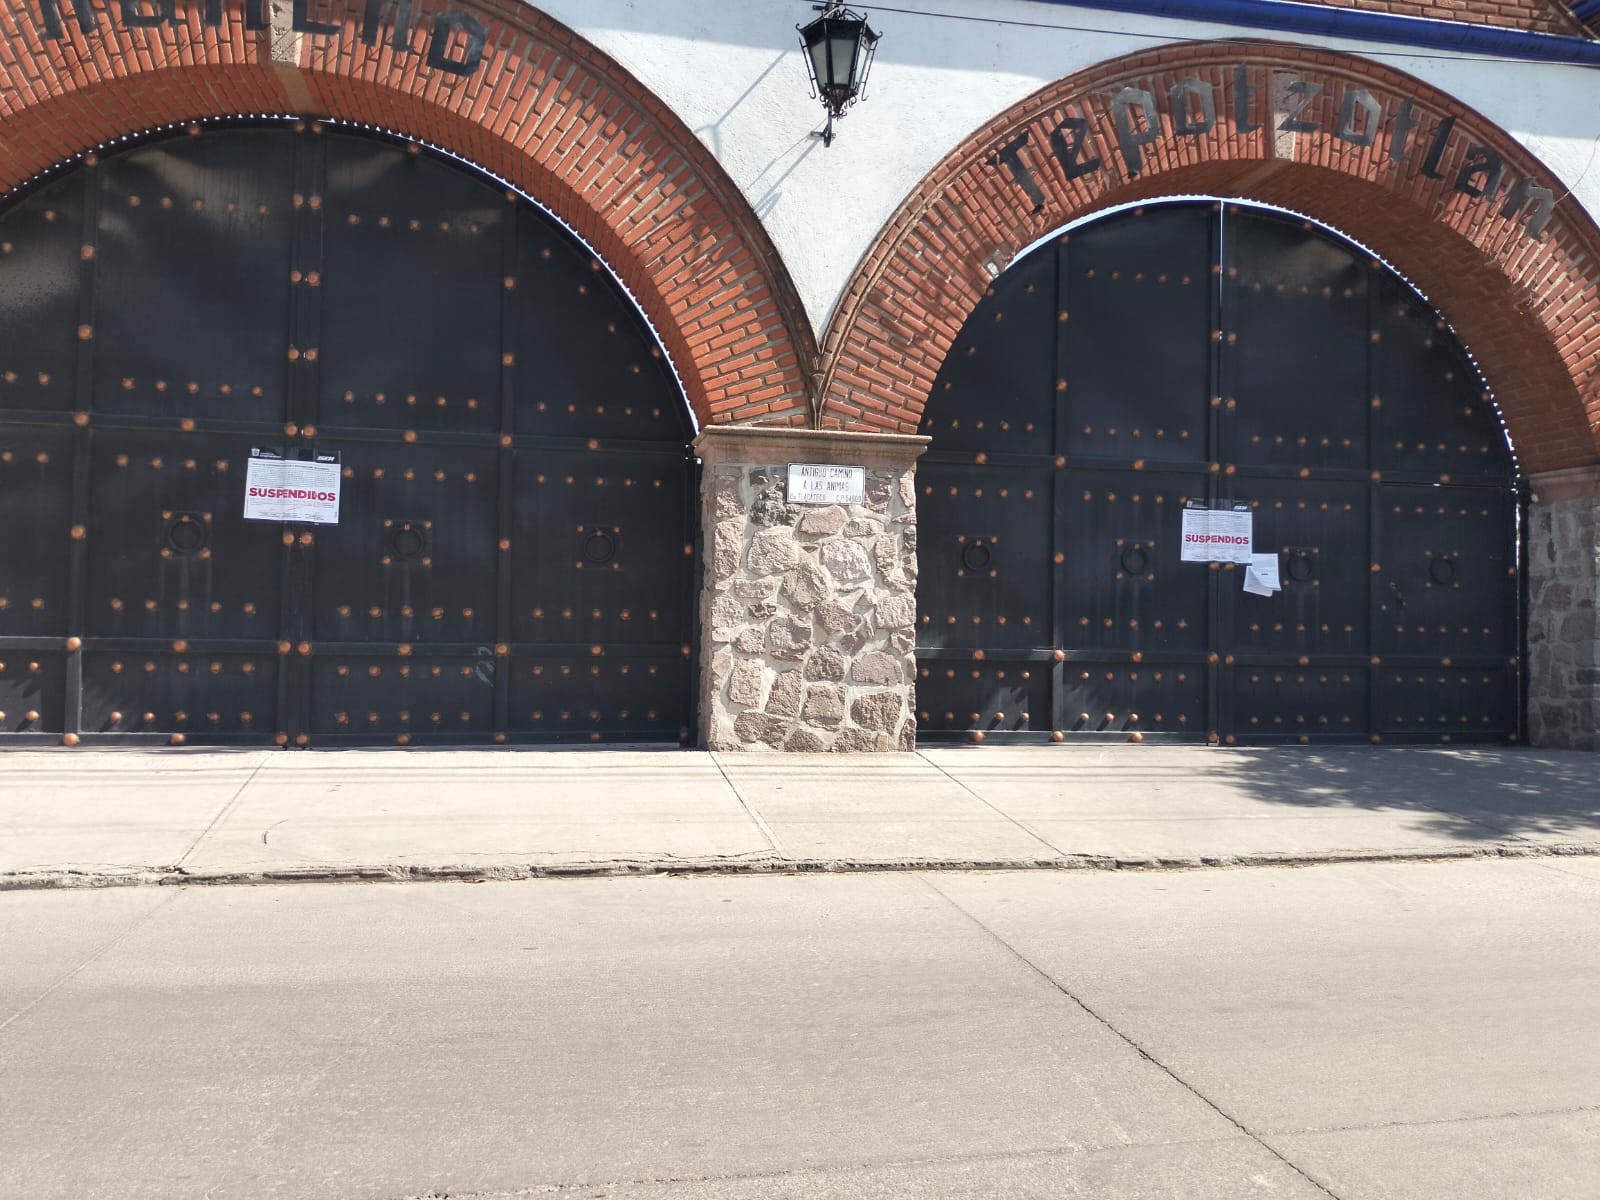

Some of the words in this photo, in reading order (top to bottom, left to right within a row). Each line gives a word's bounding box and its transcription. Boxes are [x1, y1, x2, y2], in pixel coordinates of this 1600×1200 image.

[987, 64, 1557, 240] Tepotzotlan
[801, 466, 827, 478] ANTIGUO
[829, 467, 853, 479] CAMINO
[803, 479, 808, 490] A
[810, 480, 823, 490] LAS
[826, 481, 849, 492] ANIMAS
